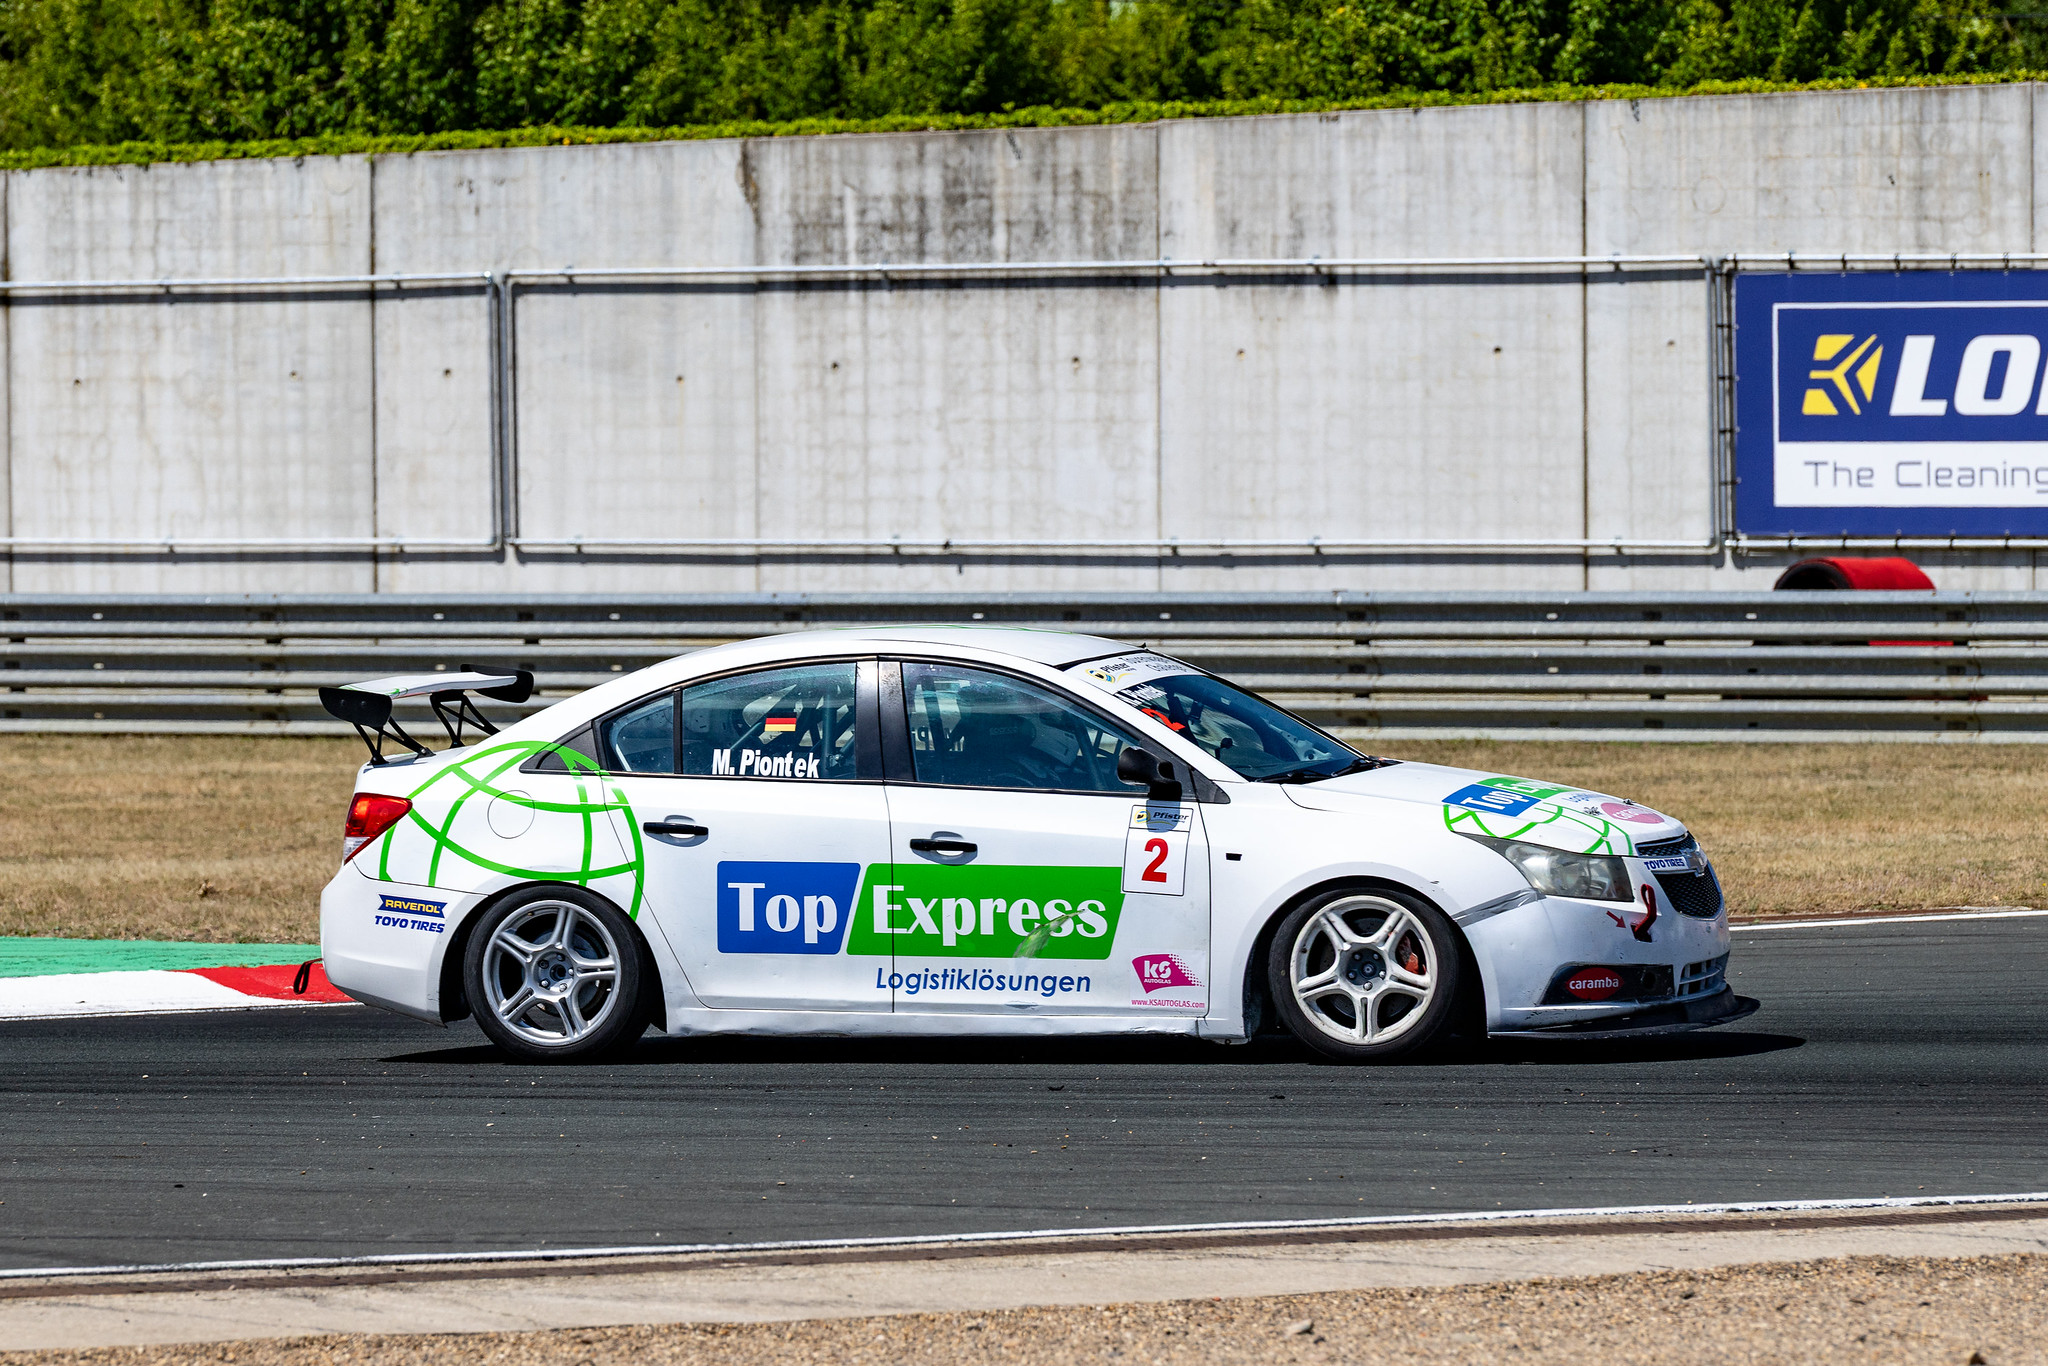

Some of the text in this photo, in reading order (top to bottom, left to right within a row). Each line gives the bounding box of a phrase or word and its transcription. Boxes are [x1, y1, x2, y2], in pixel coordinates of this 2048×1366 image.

[1889, 334, 2048, 416] LO
[1803, 460, 1874, 488] The
[711, 748, 820, 778] M. Piontek
[1460, 790, 1530, 810] Top
[1153, 811, 1189, 820] Pfister
[1141, 838, 1169, 883] 2
[1644, 858, 1685, 870] TOYO TIRES
[375, 915, 445, 933] TOYO TIRES
[727, 883, 1109, 947] Top Express
[876, 968, 1091, 998] Logistiklösungen
[1568, 977, 1619, 990] caramba
[1131, 999, 1205, 1008] www.KSAUTOGLAS.com
